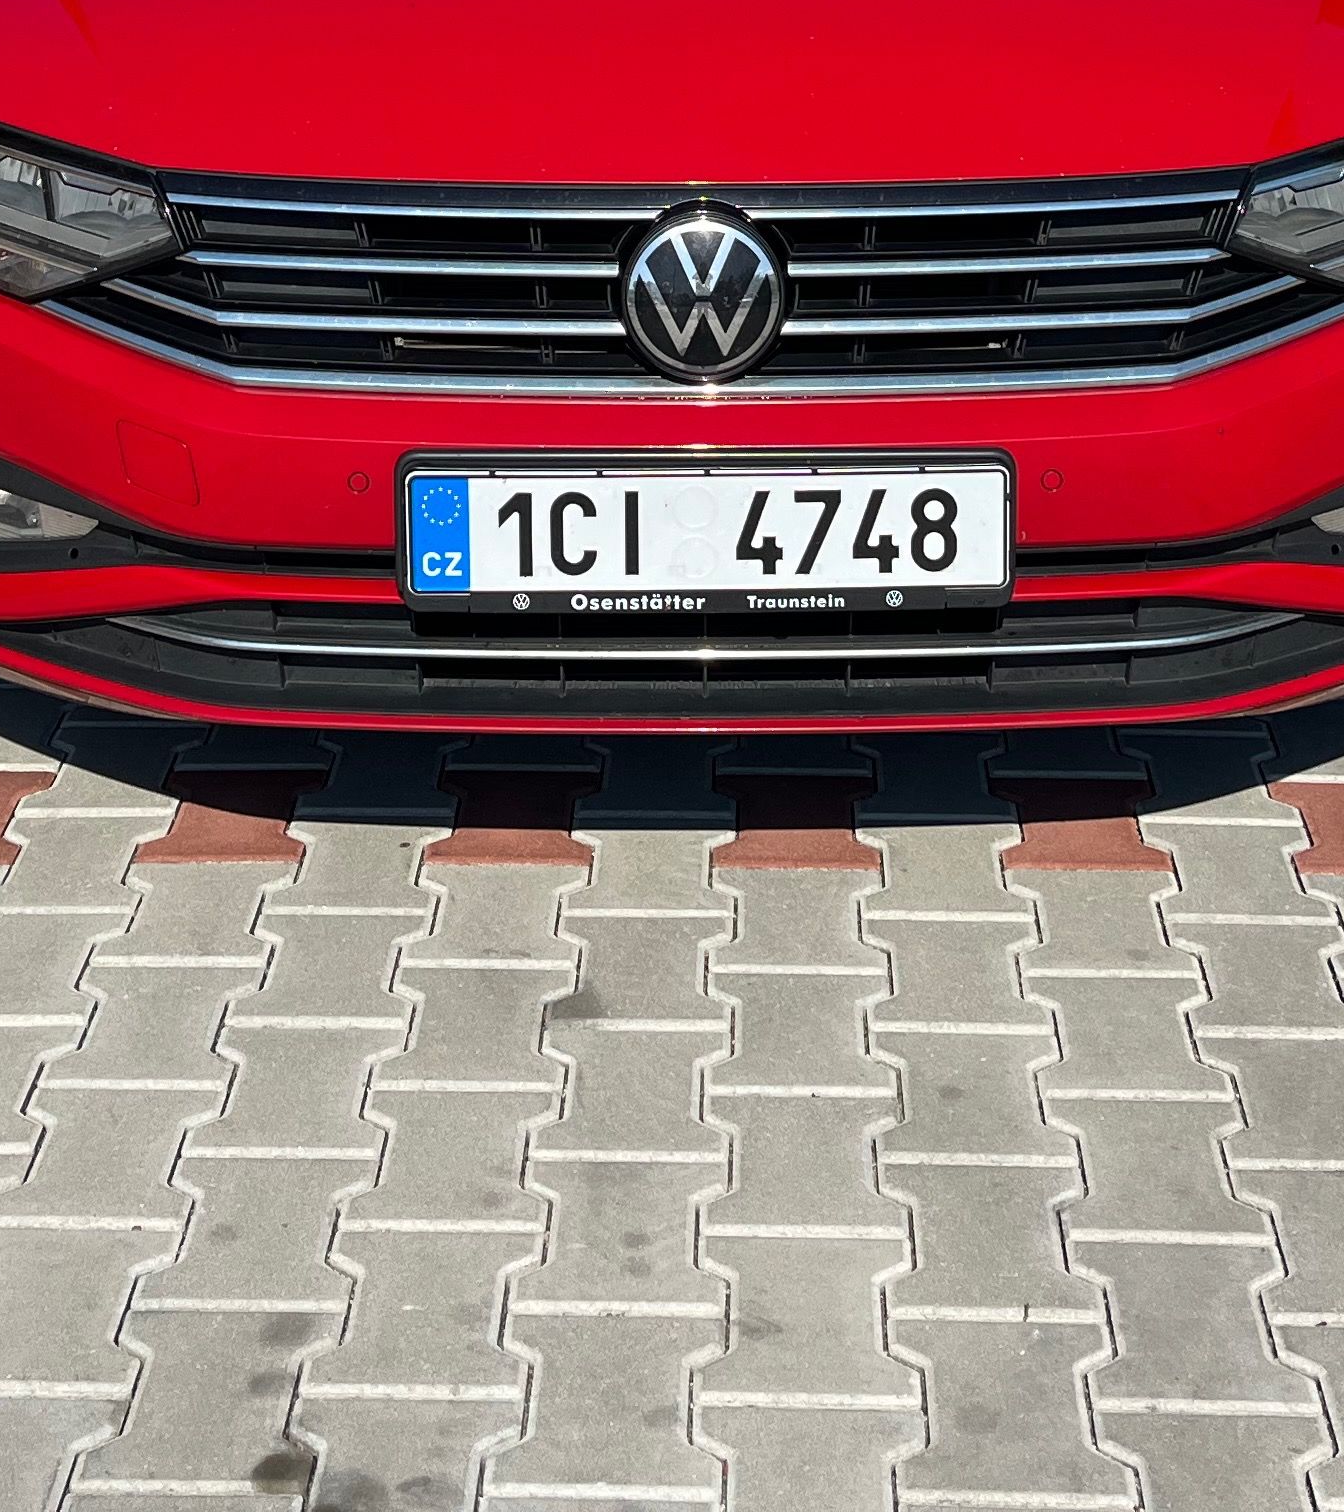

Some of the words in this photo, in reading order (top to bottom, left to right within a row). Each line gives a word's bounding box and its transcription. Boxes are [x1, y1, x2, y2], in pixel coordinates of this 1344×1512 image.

[422, 551, 463, 577] CZ
[498, 490, 639, 577] 1CI
[735, 488, 958, 576] 4748
[570, 593, 706, 610] Osenstätter
[746, 594, 846, 609] Traunstein
